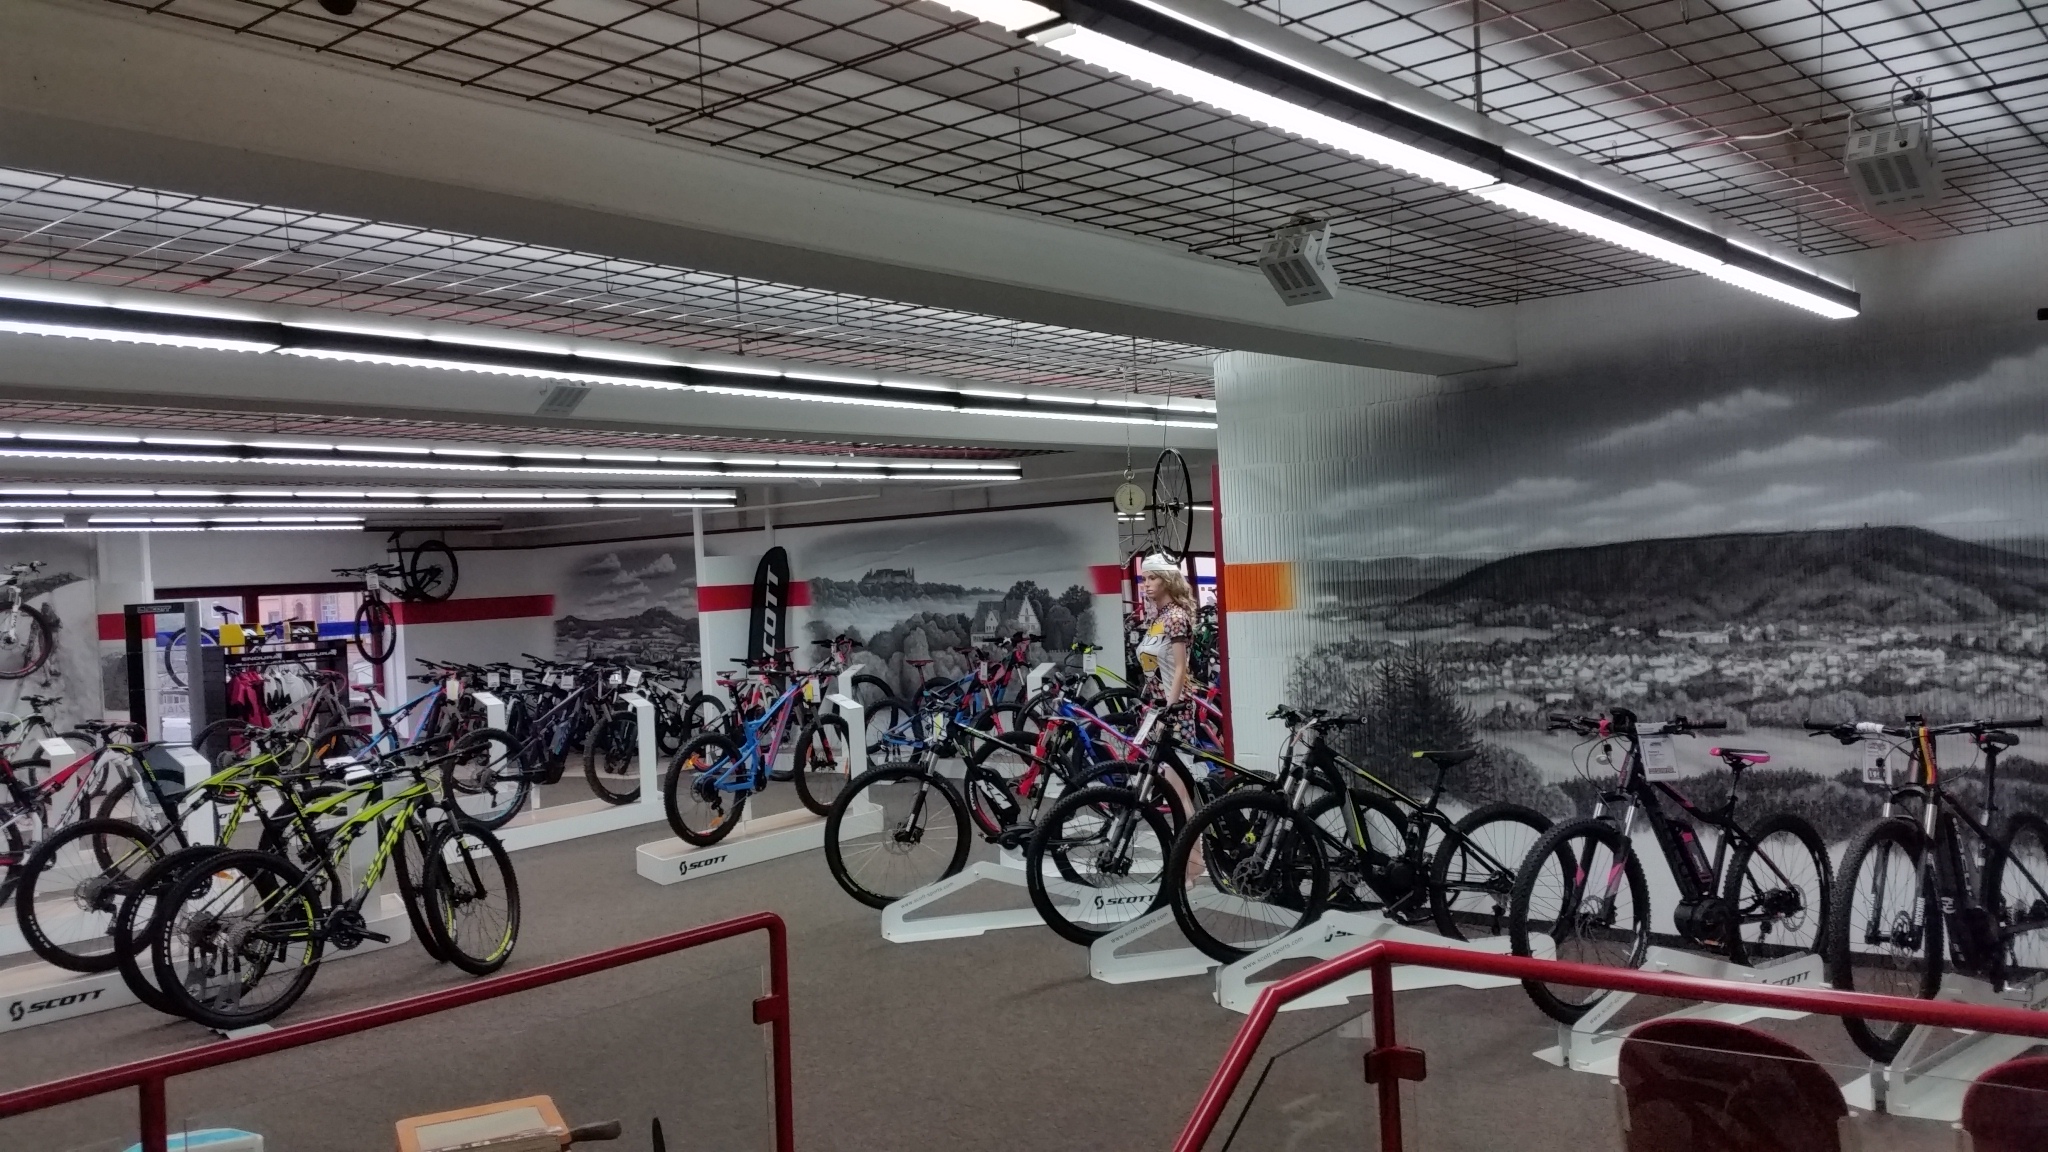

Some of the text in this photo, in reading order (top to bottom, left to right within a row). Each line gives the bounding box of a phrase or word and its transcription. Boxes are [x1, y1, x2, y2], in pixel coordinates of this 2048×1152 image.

[762, 564, 779, 660] COTT
[975, 779, 1012, 809] KTM
[688, 855, 728, 870] SCOTT
[1106, 895, 1157, 906] SCOTT
[1110, 911, 1169, 944] www.scott-sports.com
[1242, 936, 1304, 971] www.scott-sports.com
[27, 988, 106, 1014] SCOTT
